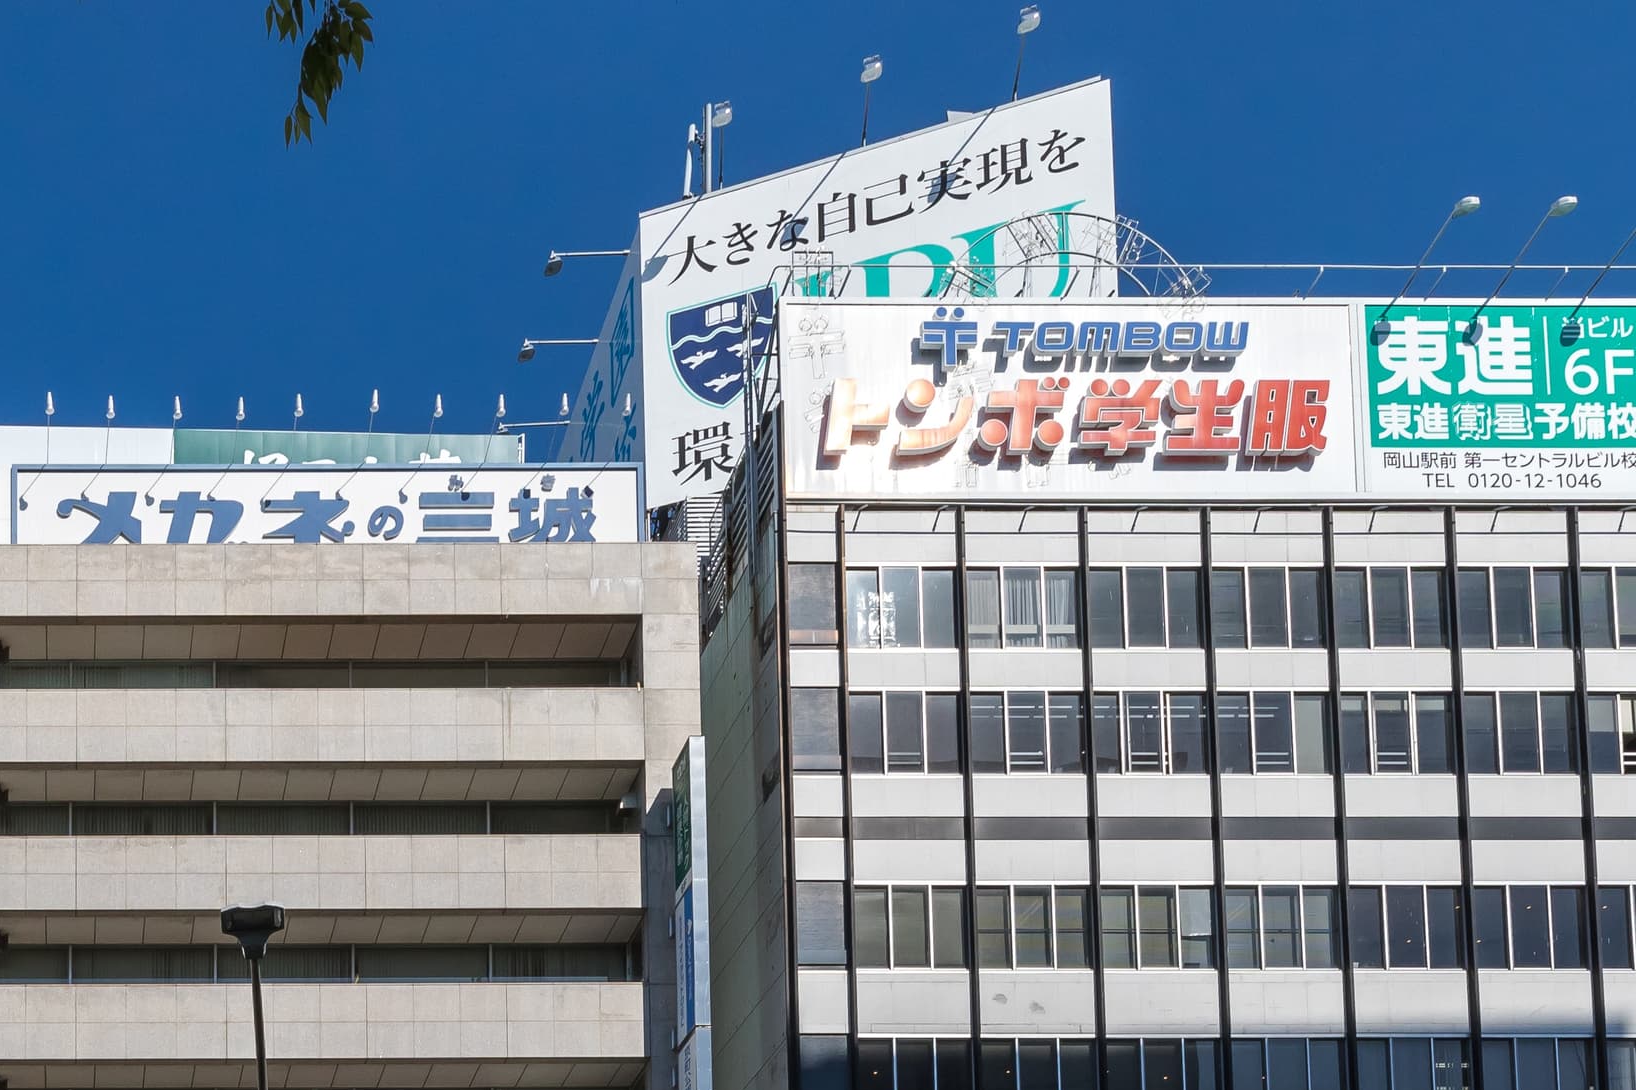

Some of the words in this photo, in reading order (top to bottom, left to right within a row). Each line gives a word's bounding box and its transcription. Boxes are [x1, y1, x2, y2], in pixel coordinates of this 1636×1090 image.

[668, 129, 1086, 286] 大きな自己実現を
[995, 320, 1249, 356] TOMBOW
[1374, 315, 1534, 395] 東進
[1565, 348, 1636, 395] 6F
[824, 377, 1331, 457] トンボ学生服
[1376, 402, 1636, 440] 東進衛星予備校
[1383, 452, 1457, 469] 岡山駅前
[1463, 451, 1636, 469] 第一セントラルビル校
[1422, 473, 1455, 488] TEL
[1467, 473, 1602, 489] 0120-12-1046
